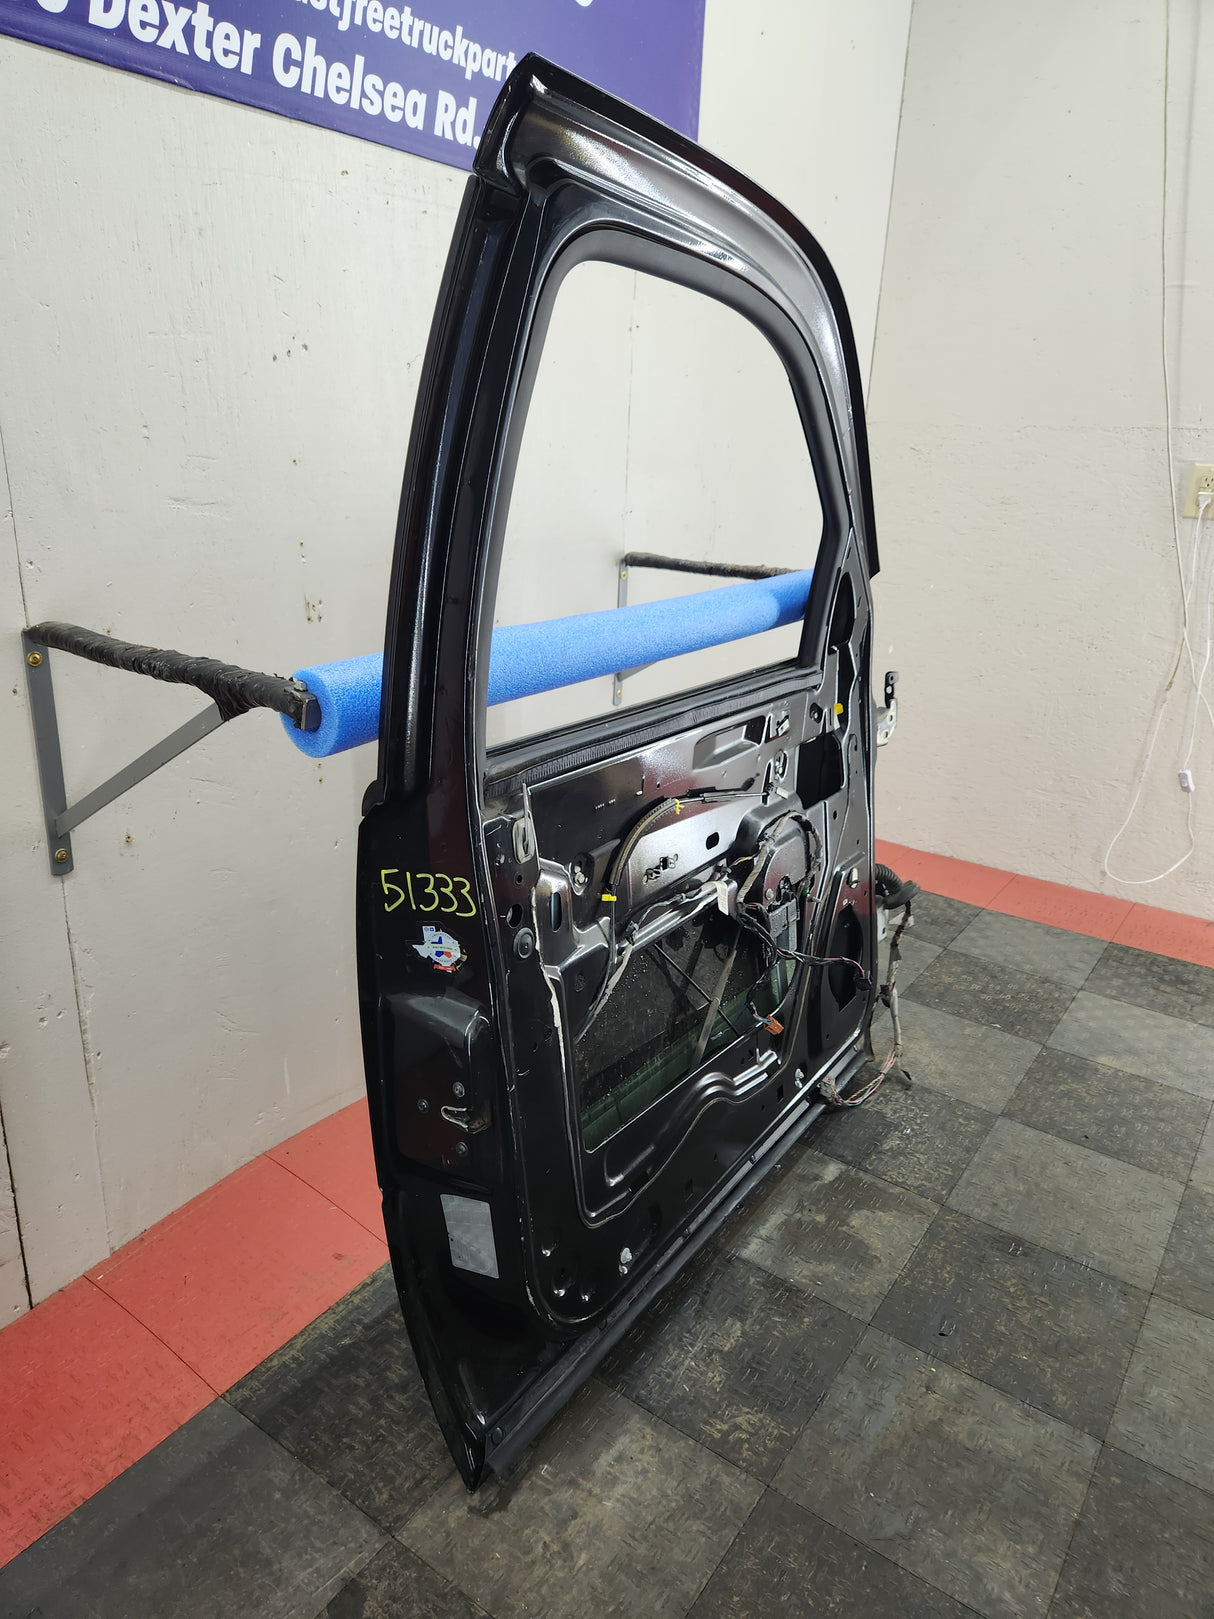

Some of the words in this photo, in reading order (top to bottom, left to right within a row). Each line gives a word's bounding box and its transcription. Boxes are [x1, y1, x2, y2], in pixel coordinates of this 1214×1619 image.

[88, 0, 262, 75] Dexter
[272, 32, 427, 130] Chelsea
[433, 89, 481, 150] Rd.
[381, 868, 477, 917] 51333
